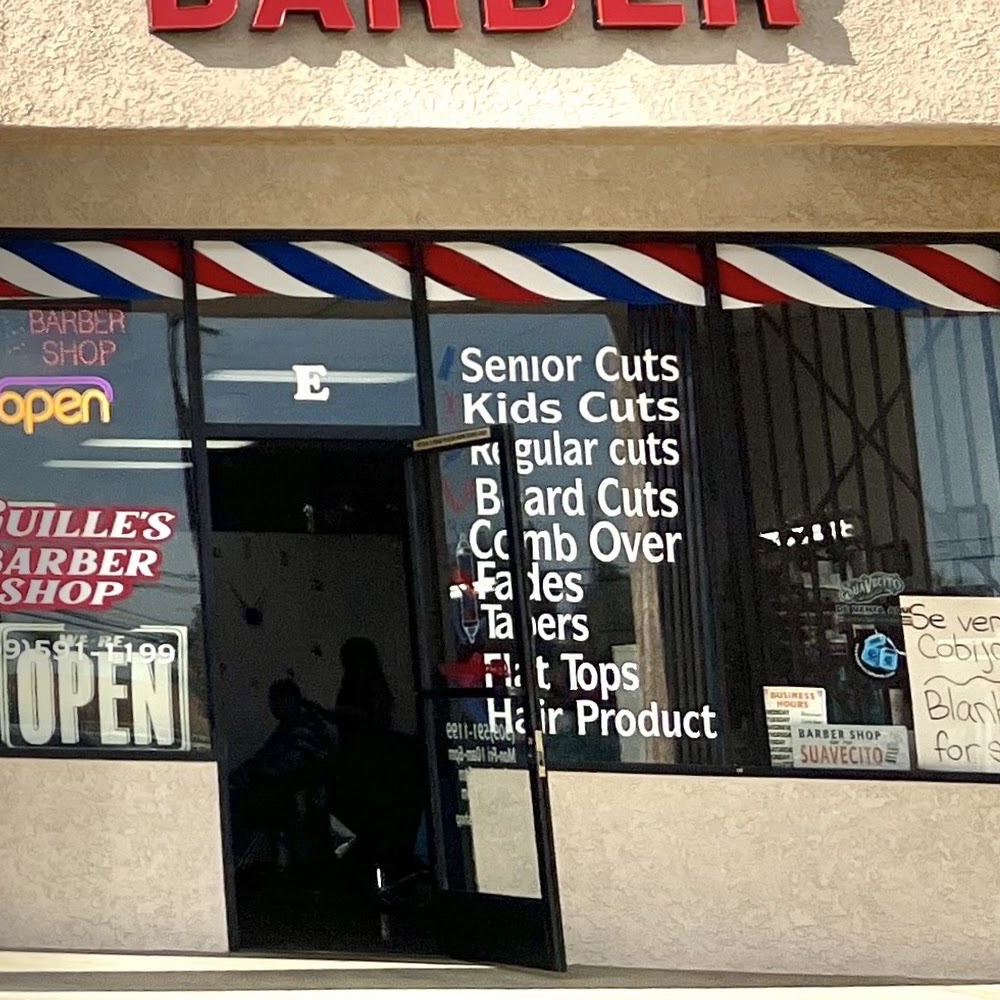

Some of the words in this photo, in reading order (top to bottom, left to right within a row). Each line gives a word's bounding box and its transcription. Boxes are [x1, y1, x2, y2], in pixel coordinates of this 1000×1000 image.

[29, 309, 127, 334] BARBER
[42, 340, 117, 366] SHOP
[461, 346, 582, 383] Senior
[595, 346, 680, 382] Cuts
[293, 365, 329, 401] E
[463, 392, 563, 424] Kids
[579, 391, 680, 423] Cuts
[609, 435, 680, 466] cuts
[475, 477, 584, 517] Bard
[597, 477, 679, 518] Cuts
[469, 519, 578, 562] Comb
[589, 521, 682, 564] Over
[480, 603, 590, 642] Taers
[910, 603, 947, 630] Se
[560, 653, 640, 700] Tops
[16, 650, 173, 745] OPEN
[486, 697, 564, 735] Hair
[577, 700, 718, 739] Product
[798, 728, 846, 740] BARBER
[850, 729, 881, 740] SHOP
[800, 745, 883, 764] SUAVECITO
[934, 730, 981, 762] for
